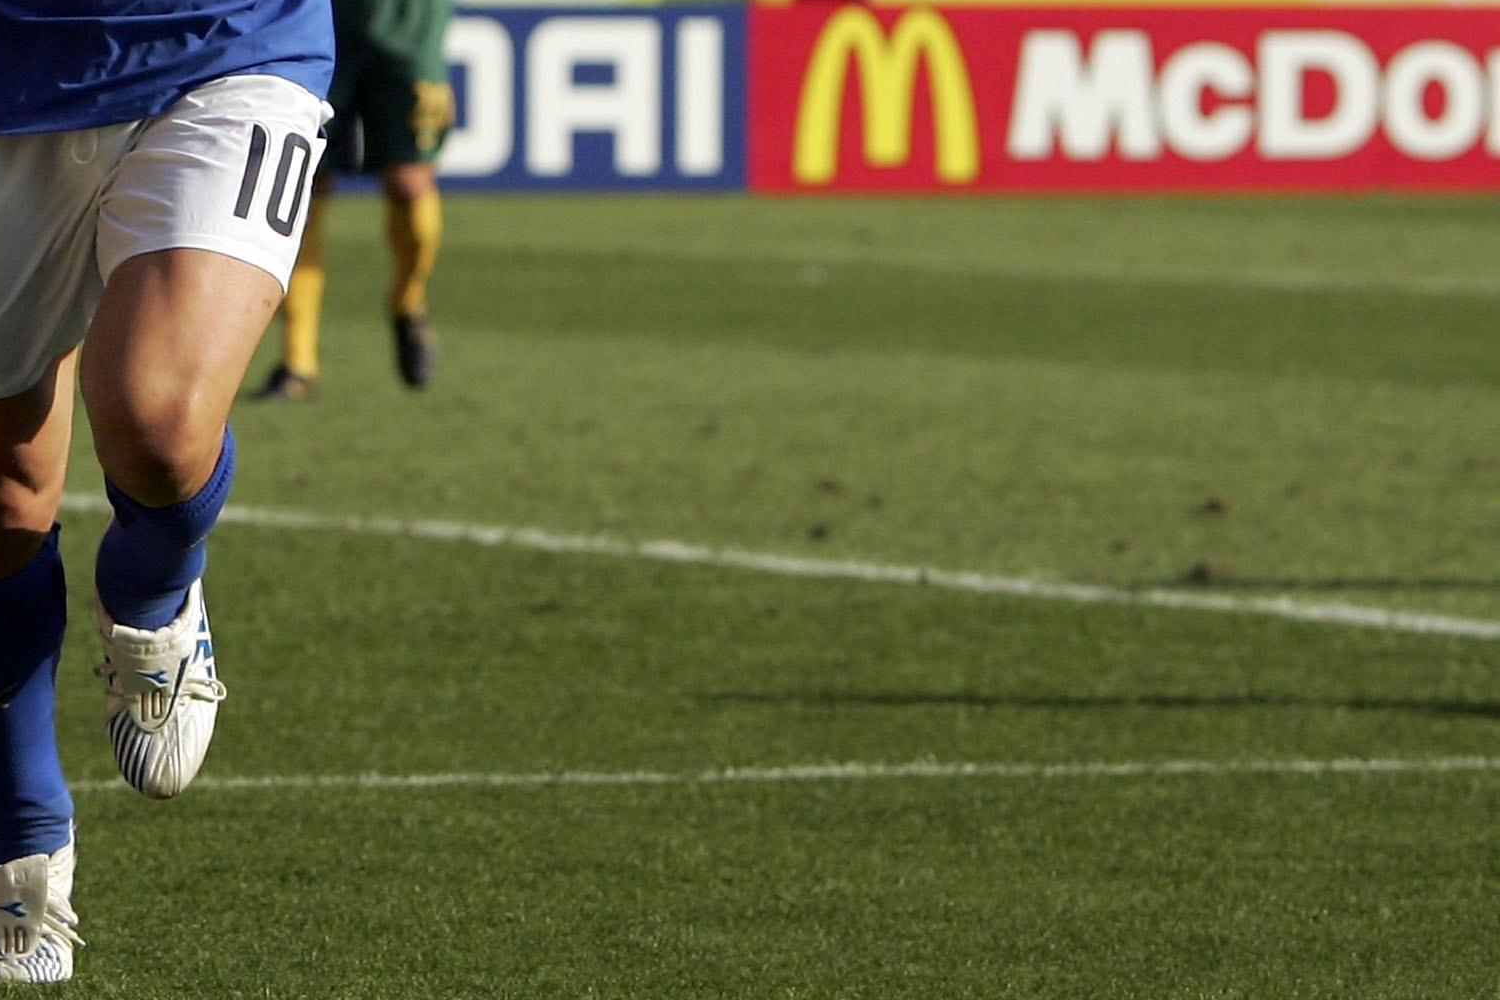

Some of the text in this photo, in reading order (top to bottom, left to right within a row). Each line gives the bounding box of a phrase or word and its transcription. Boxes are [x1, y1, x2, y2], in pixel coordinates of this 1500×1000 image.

[1006, 29, 1500, 161] McDo
[234, 123, 311, 237] 10
[141, 687, 167, 721] 10
